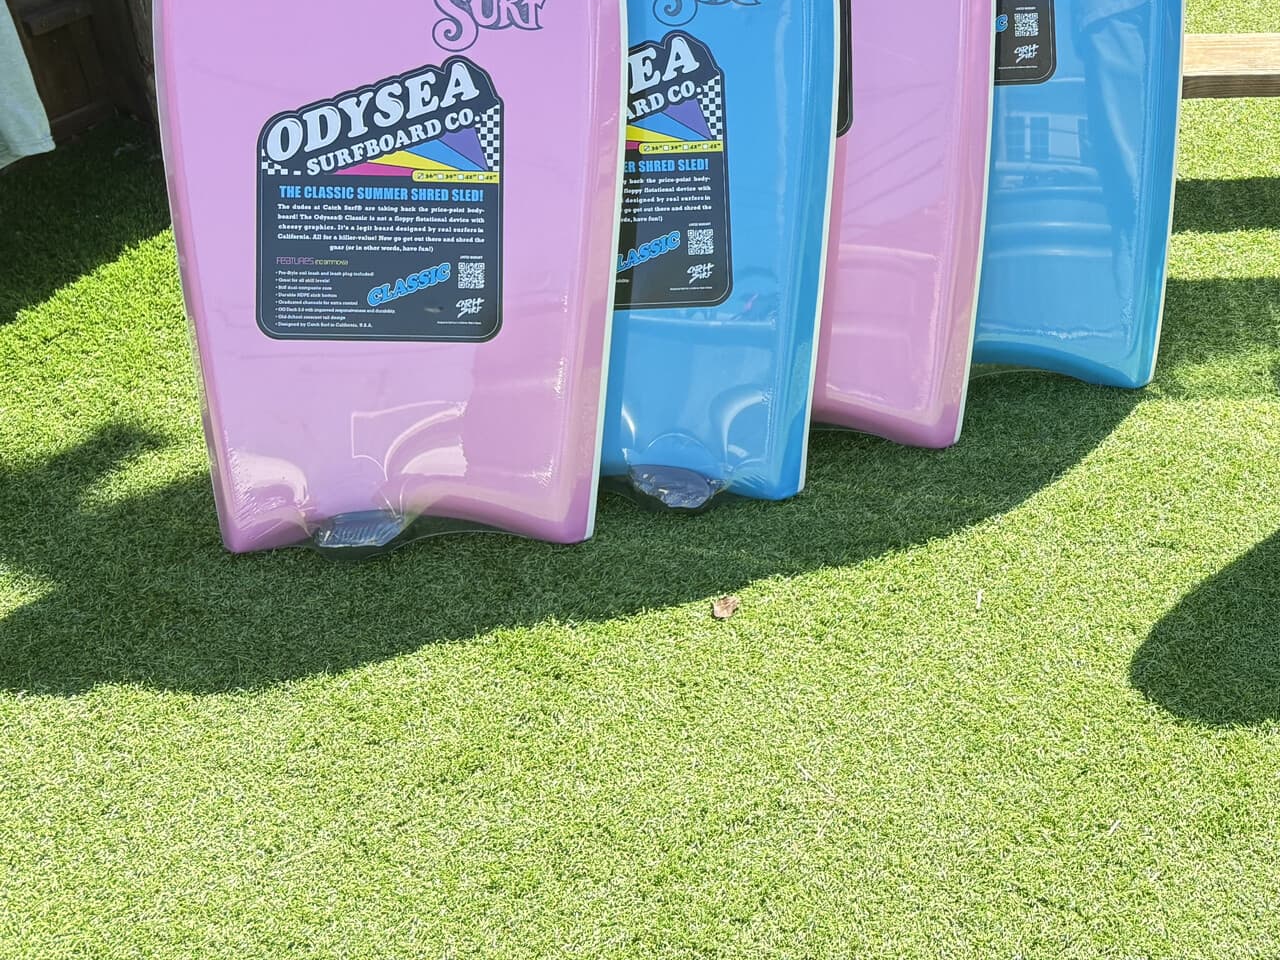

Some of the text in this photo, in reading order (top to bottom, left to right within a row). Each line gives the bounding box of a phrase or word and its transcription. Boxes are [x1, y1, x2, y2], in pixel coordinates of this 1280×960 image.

[668, 80, 701, 102] CO.
[266, 62, 479, 162] ODYSEA
[306, 108, 481, 176] SURFBOARD CO.
[639, 158, 709, 172] SHRED SLED!
[280, 186, 484, 202] THE CLASSIC SUMMER SHRED SLED!
[357, 225, 372, 233] legit
[428, 226, 437, 234] by
[617, 231, 680, 273] LASSIC
[367, 263, 451, 306] CLASSIC
